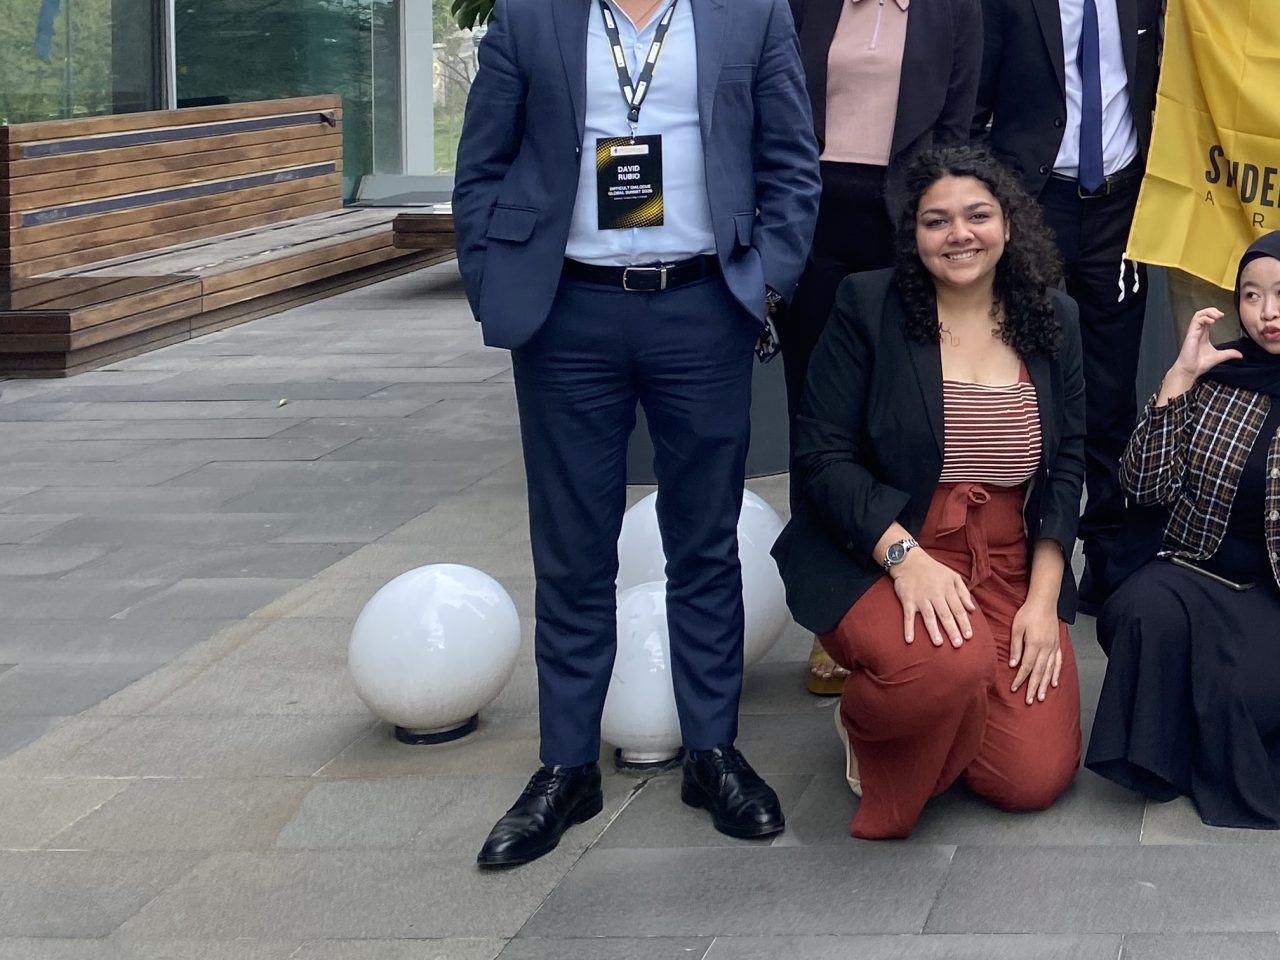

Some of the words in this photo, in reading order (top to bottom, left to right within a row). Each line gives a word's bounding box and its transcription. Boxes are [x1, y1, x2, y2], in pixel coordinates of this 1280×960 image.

[617, 165, 640, 173] DAVID
[617, 173, 640, 181] RUBIO
[1205, 190, 1215, 206] A
